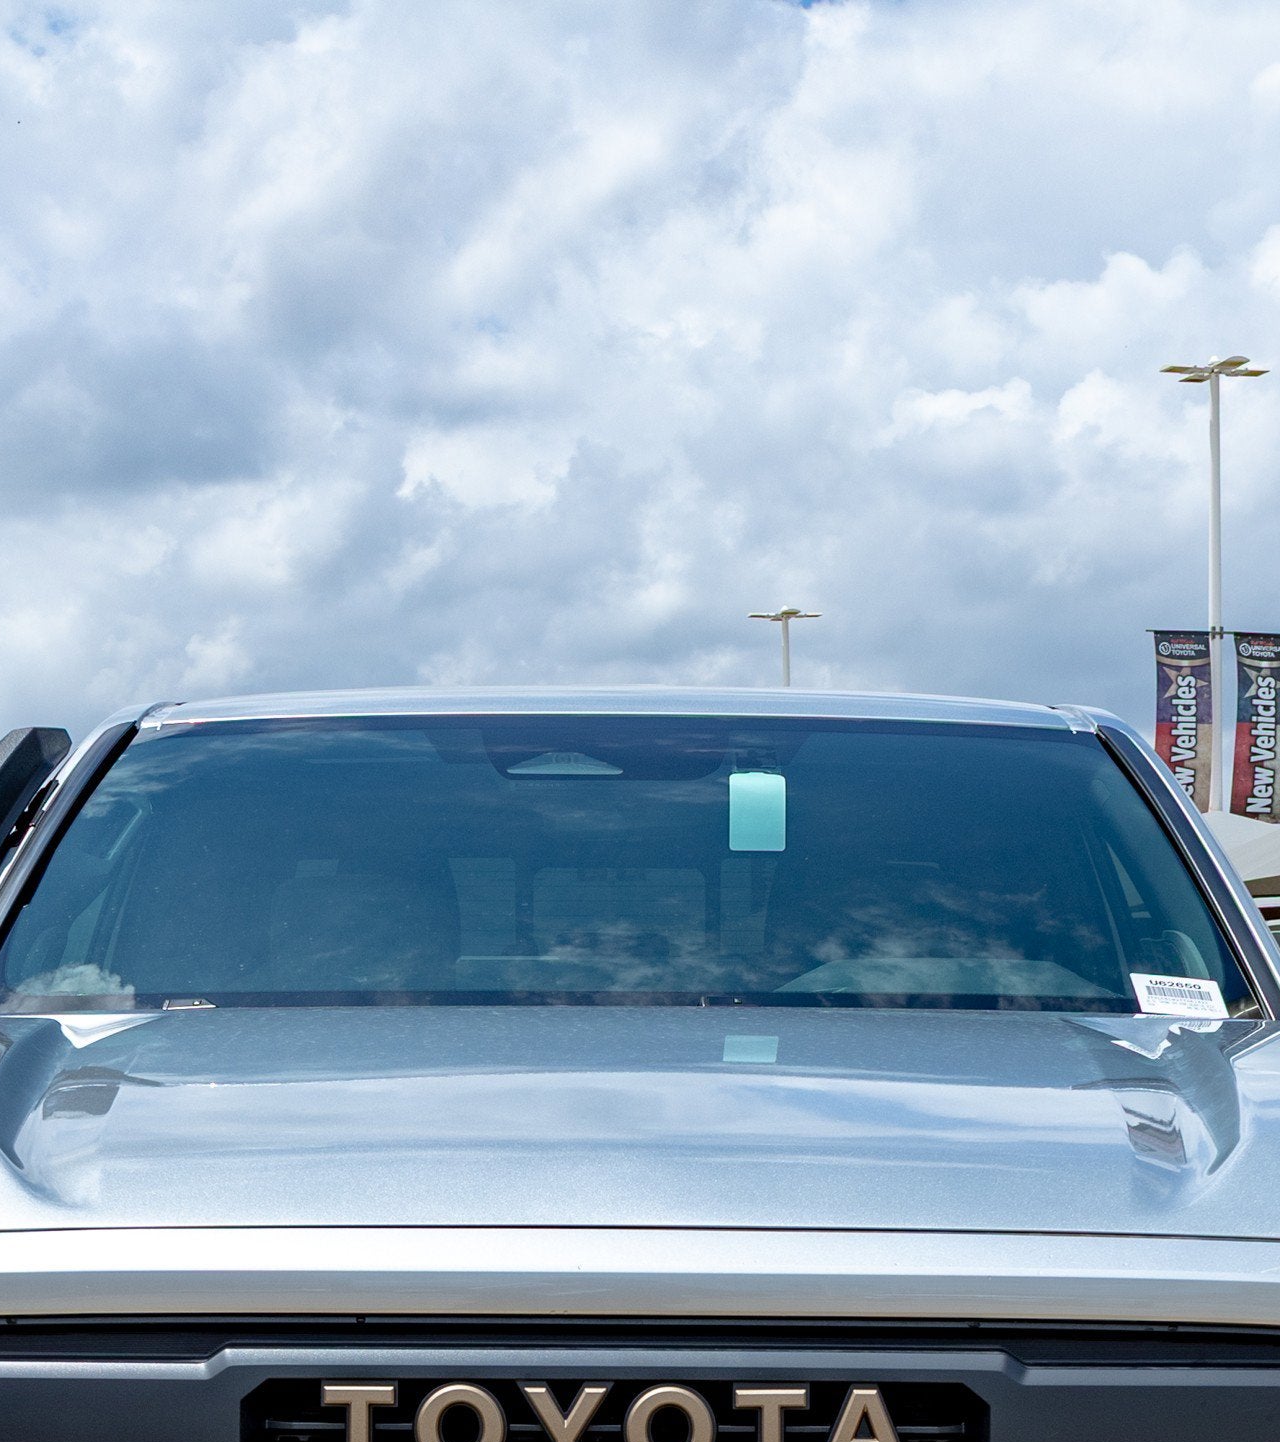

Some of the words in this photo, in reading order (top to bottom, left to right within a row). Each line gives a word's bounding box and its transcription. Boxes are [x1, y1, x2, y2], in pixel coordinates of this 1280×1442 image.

[1171, 643, 1207, 651] UNIVERSAL
[1170, 675, 1197, 763] Vehicles
[1249, 676, 1276, 763] Vehicles
[1245, 766, 1275, 814] New
